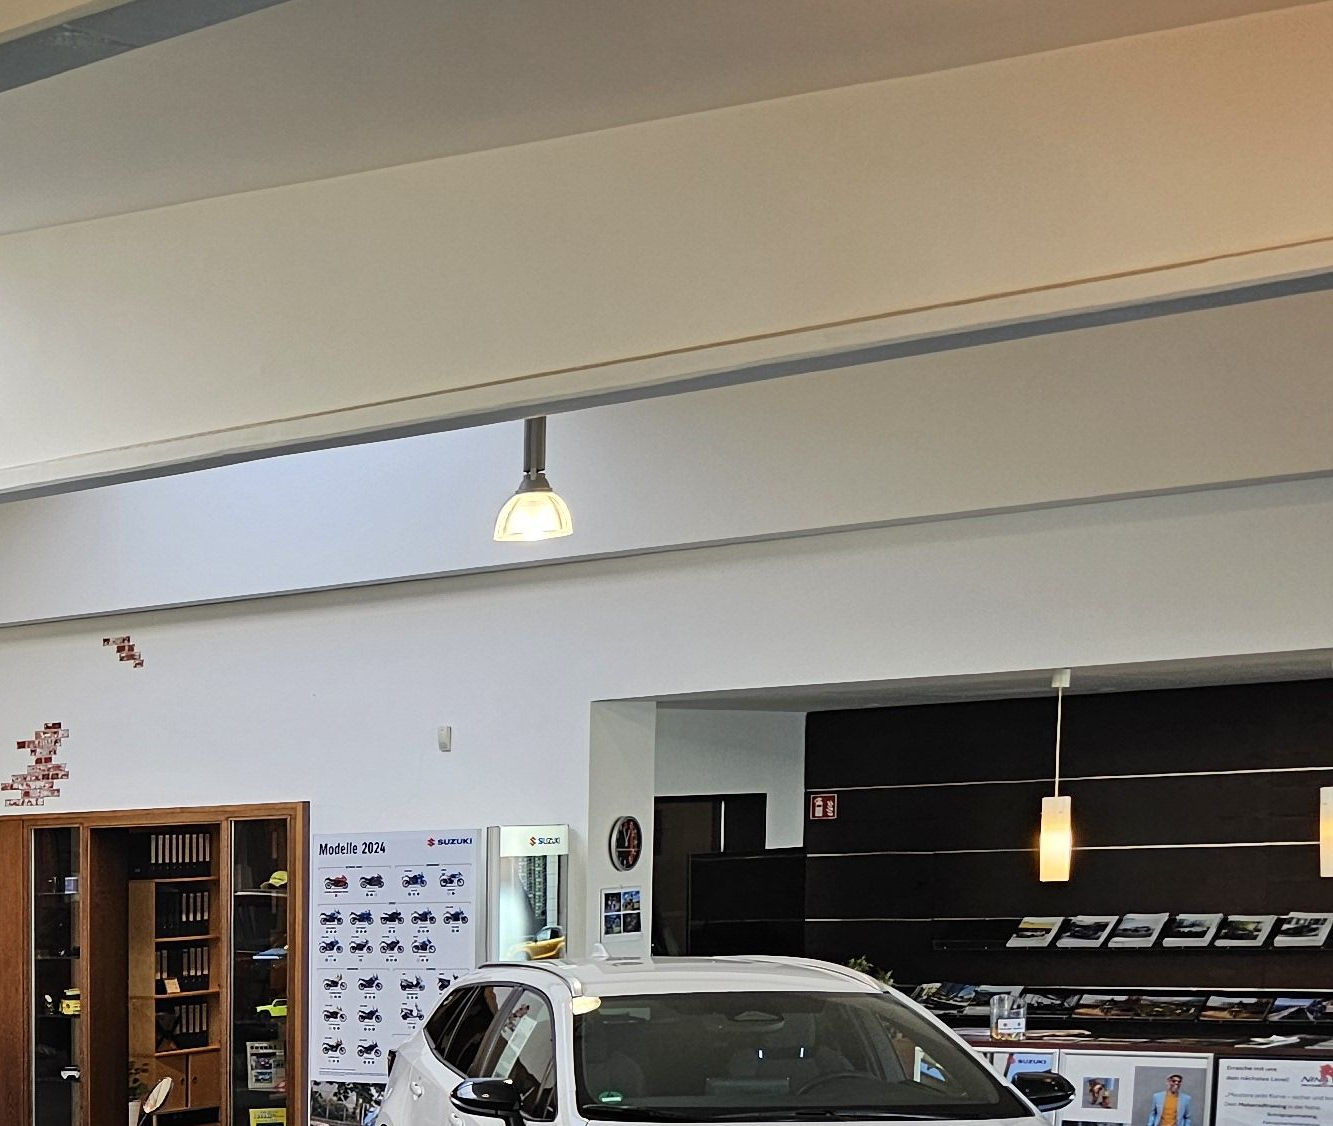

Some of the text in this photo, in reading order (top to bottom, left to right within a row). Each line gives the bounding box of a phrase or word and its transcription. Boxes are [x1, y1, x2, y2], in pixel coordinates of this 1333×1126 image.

[437, 838, 473, 846] SUZUKI
[318, 841, 386, 856] Modelle 2024
[1018, 1058, 1047, 1066] SUZUKI
